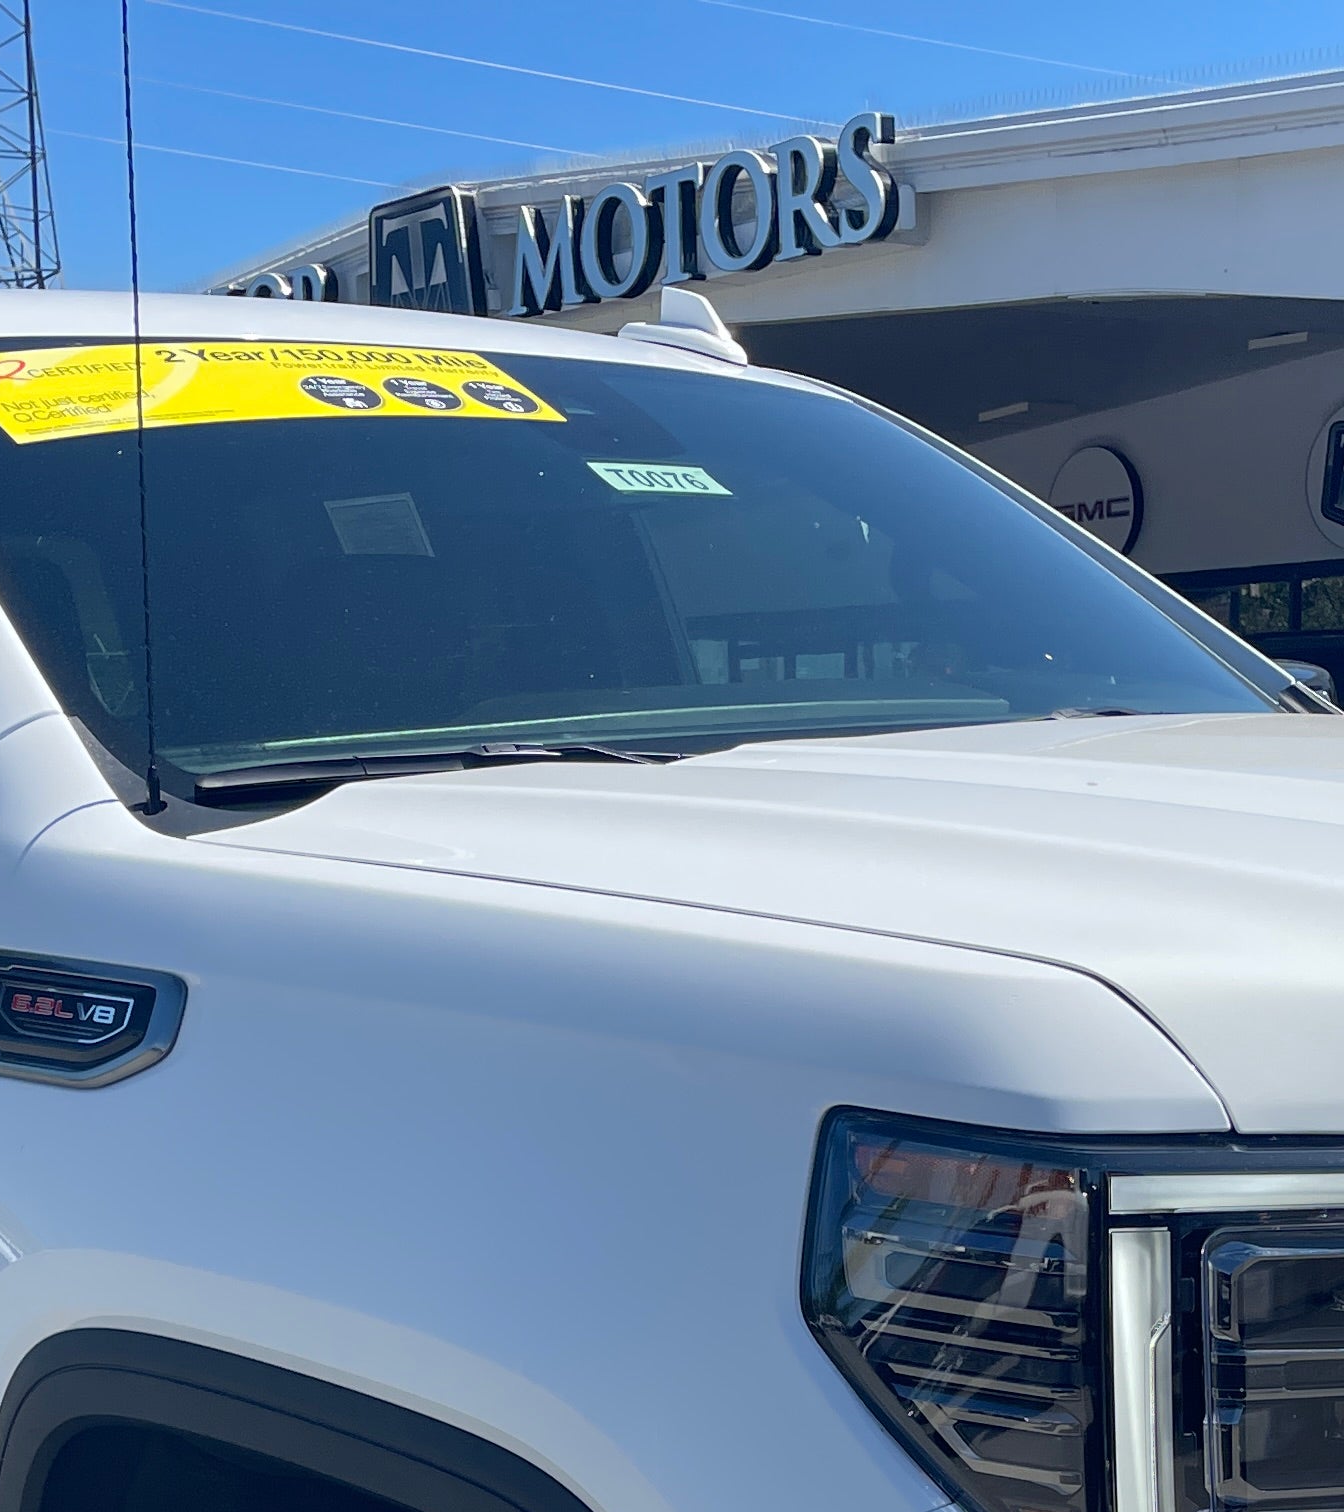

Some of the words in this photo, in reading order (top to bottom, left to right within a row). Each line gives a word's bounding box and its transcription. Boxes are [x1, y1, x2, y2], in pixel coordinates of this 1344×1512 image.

[508, 112, 898, 316] MOTORS
[156, 350, 185, 363] 2
[413, 353, 488, 369] Mile
[28, 362, 139, 379] CERTIFIED
[1, 399, 38, 413] Not
[39, 395, 77, 410] just
[604, 468, 710, 490] T0076
[10, 993, 74, 1019] 6.2L
[76, 1001, 116, 1025] V8
